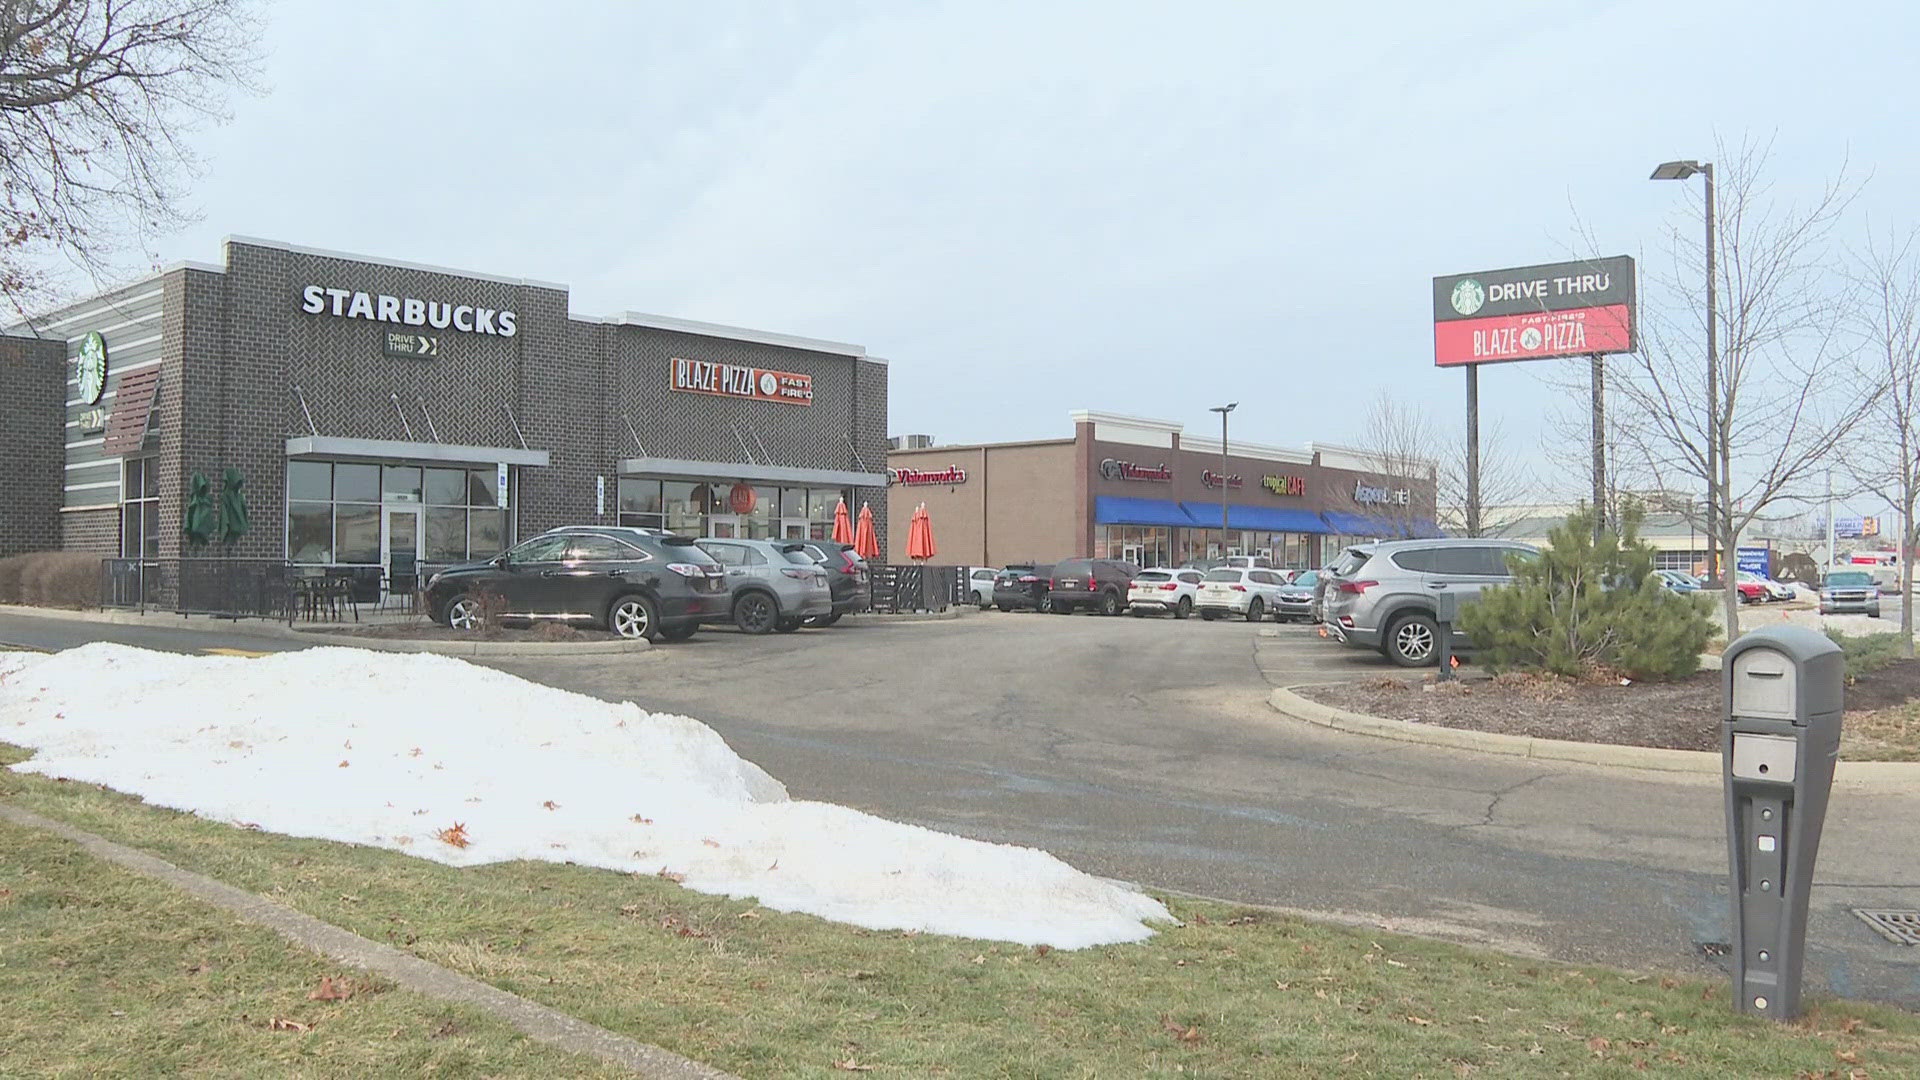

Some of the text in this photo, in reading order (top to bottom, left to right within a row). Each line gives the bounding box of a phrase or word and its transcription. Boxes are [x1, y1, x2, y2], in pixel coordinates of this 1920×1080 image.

[1489, 273, 1610, 302] DRIVE THRU
[302, 285, 517, 338] STARBUCKS
[388, 332, 415, 344] DRIVE
[388, 342, 414, 353] THRU
[1473, 322, 1586, 357] BLAZE PIZZA
[677, 359, 756, 396] BLAZE PIZZA
[896, 464, 966, 487] Visionworks
